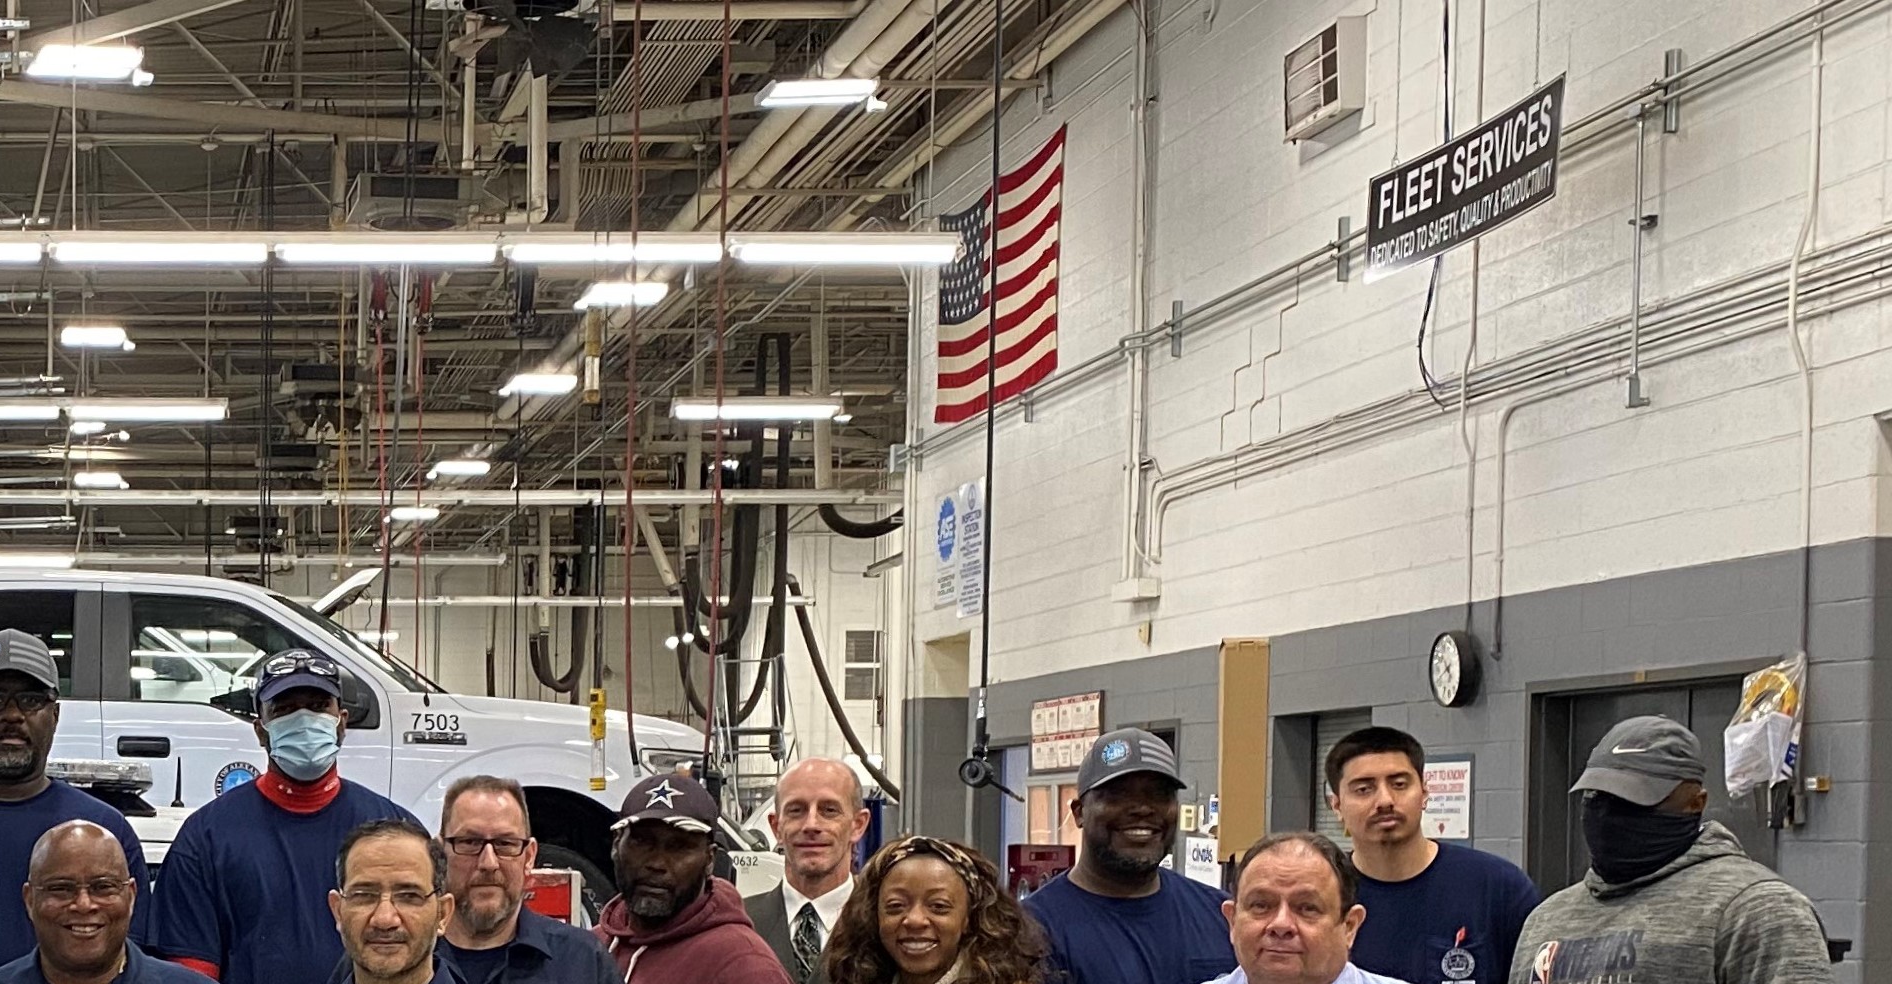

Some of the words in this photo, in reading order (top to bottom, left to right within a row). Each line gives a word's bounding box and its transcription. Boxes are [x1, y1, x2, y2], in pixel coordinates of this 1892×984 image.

[1378, 154, 1448, 229] FLEET
[1451, 94, 1553, 195] SERVICES
[1370, 231, 1415, 268] DEDICATED
[1415, 227, 1428, 252] TO
[1428, 210, 1459, 250] SAFETY,
[1460, 192, 1495, 233] QUALITY
[1493, 191, 1499, 217] &
[1500, 158, 1554, 213] PRODUCTIVITY
[939, 515, 955, 540] ASE
[411, 713, 460, 732] 7503
